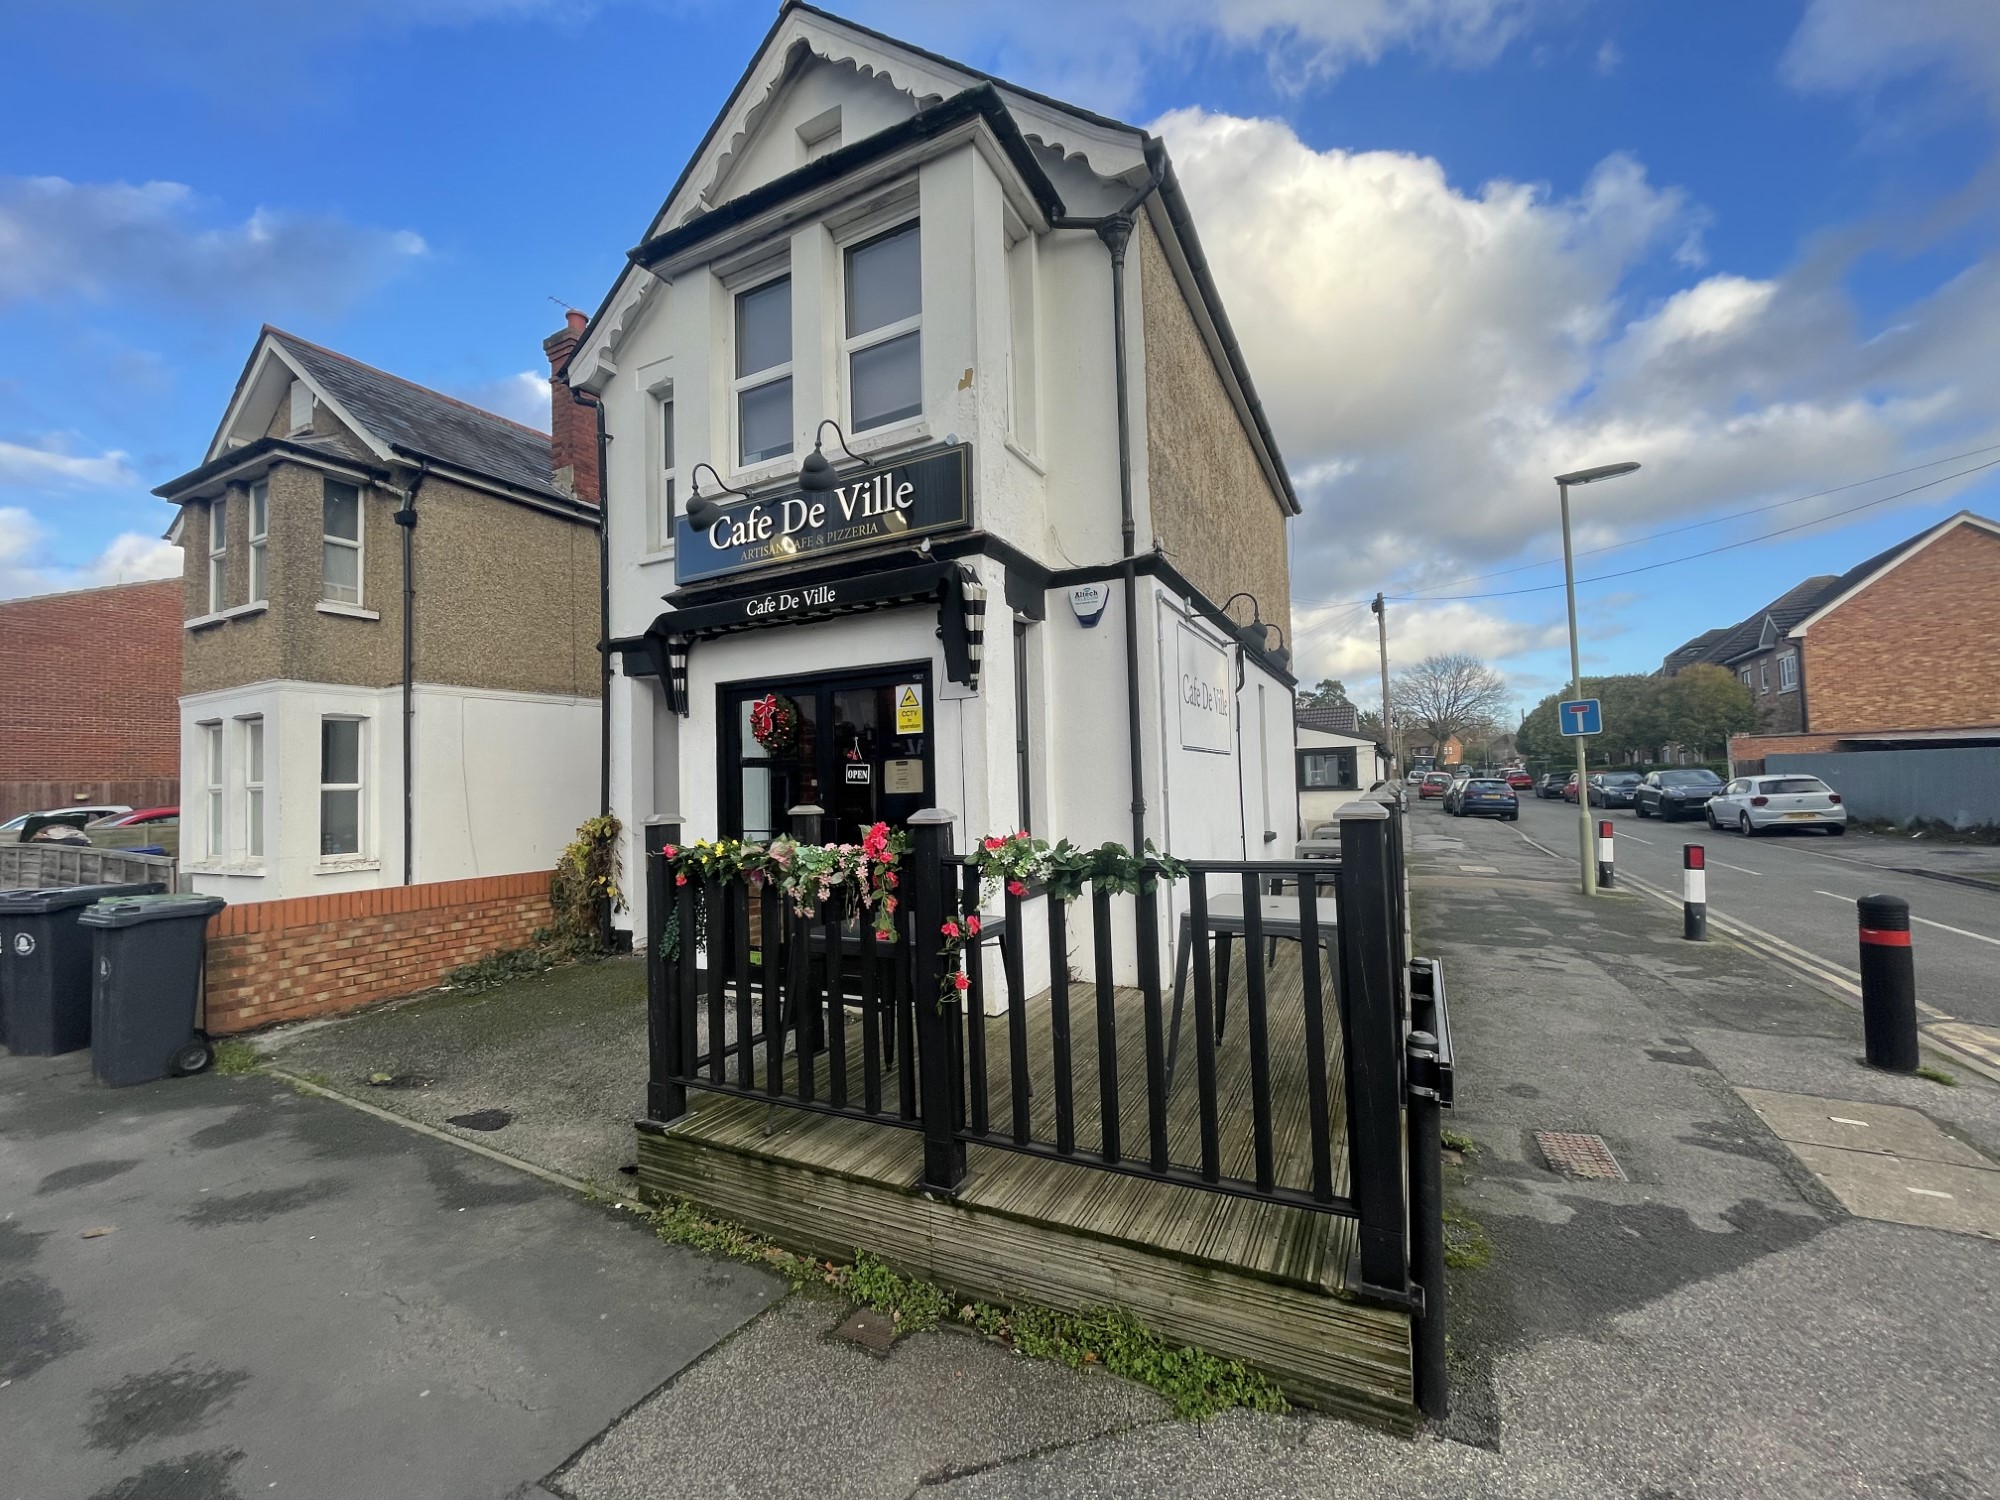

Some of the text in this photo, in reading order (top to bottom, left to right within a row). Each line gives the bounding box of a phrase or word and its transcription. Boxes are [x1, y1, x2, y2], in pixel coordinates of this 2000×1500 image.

[709, 472, 914, 550] Cafe De Ville
[741, 543, 785, 560] ARTISAN
[816, 534, 824, 544] &
[827, 522, 878, 542] PIZZERIA
[746, 586, 836, 616] Cafe De Ville
[1075, 590, 1098, 598] Altech
[1183, 674, 1227, 716] Cafe De Ville
[847, 769, 868, 779] OPEN
